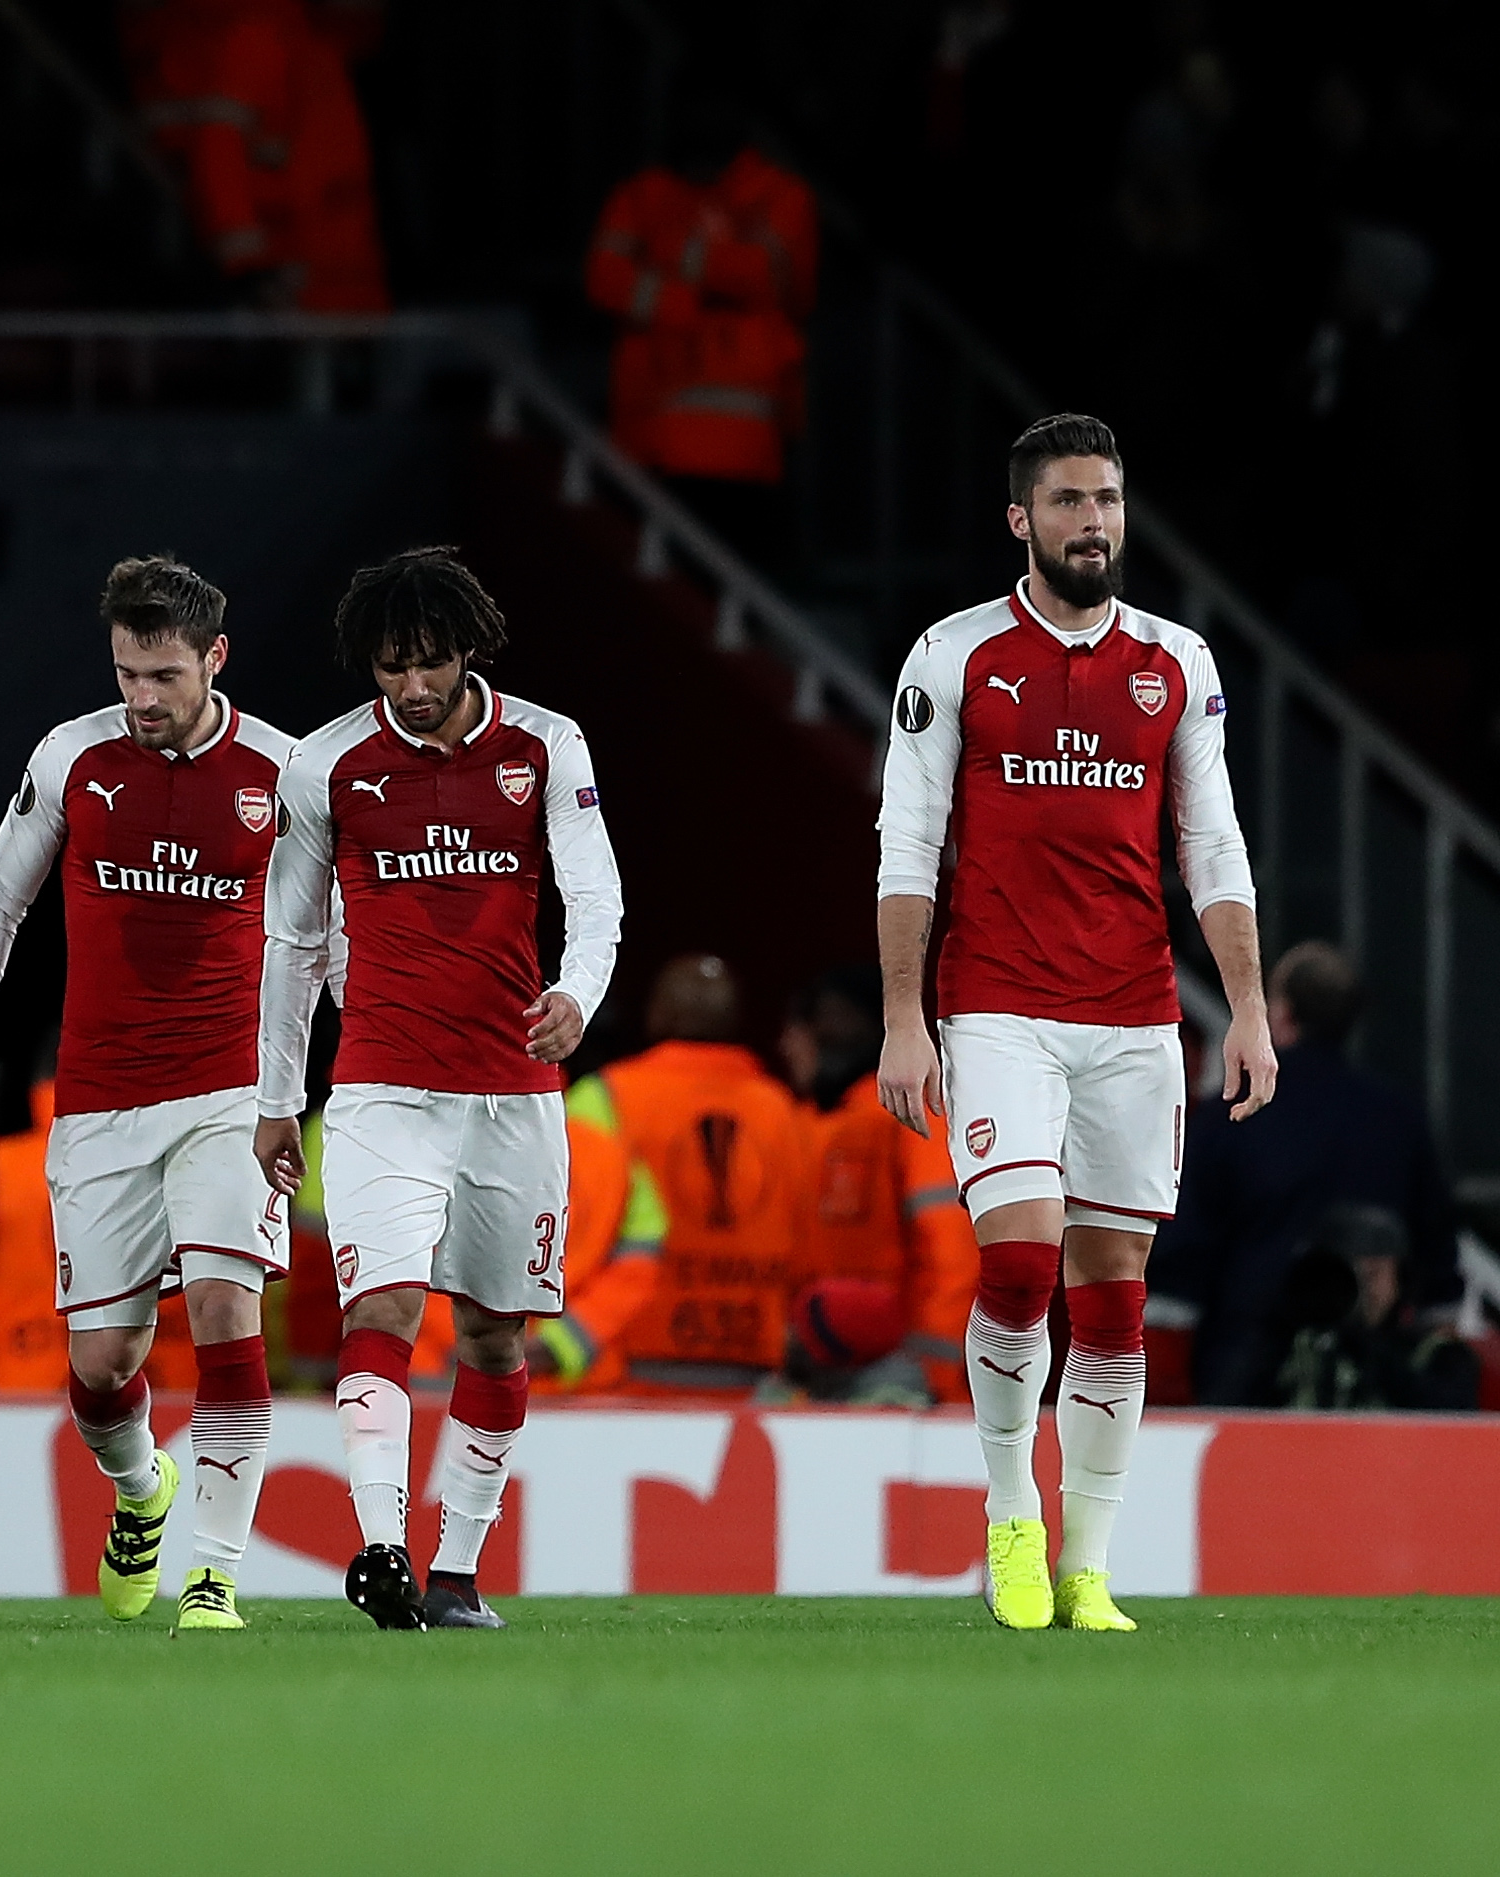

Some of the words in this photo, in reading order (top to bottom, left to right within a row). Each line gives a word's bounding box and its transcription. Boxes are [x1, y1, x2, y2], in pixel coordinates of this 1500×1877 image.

[1056, 728, 1100, 757] Fly
[1001, 753, 1145, 789] Emirates
[425, 824, 471, 851] Fly
[152, 840, 199, 871] Fly
[373, 847, 520, 880] Emirates
[94, 859, 246, 901] Emirates
[528, 1206, 567, 1276] 3
